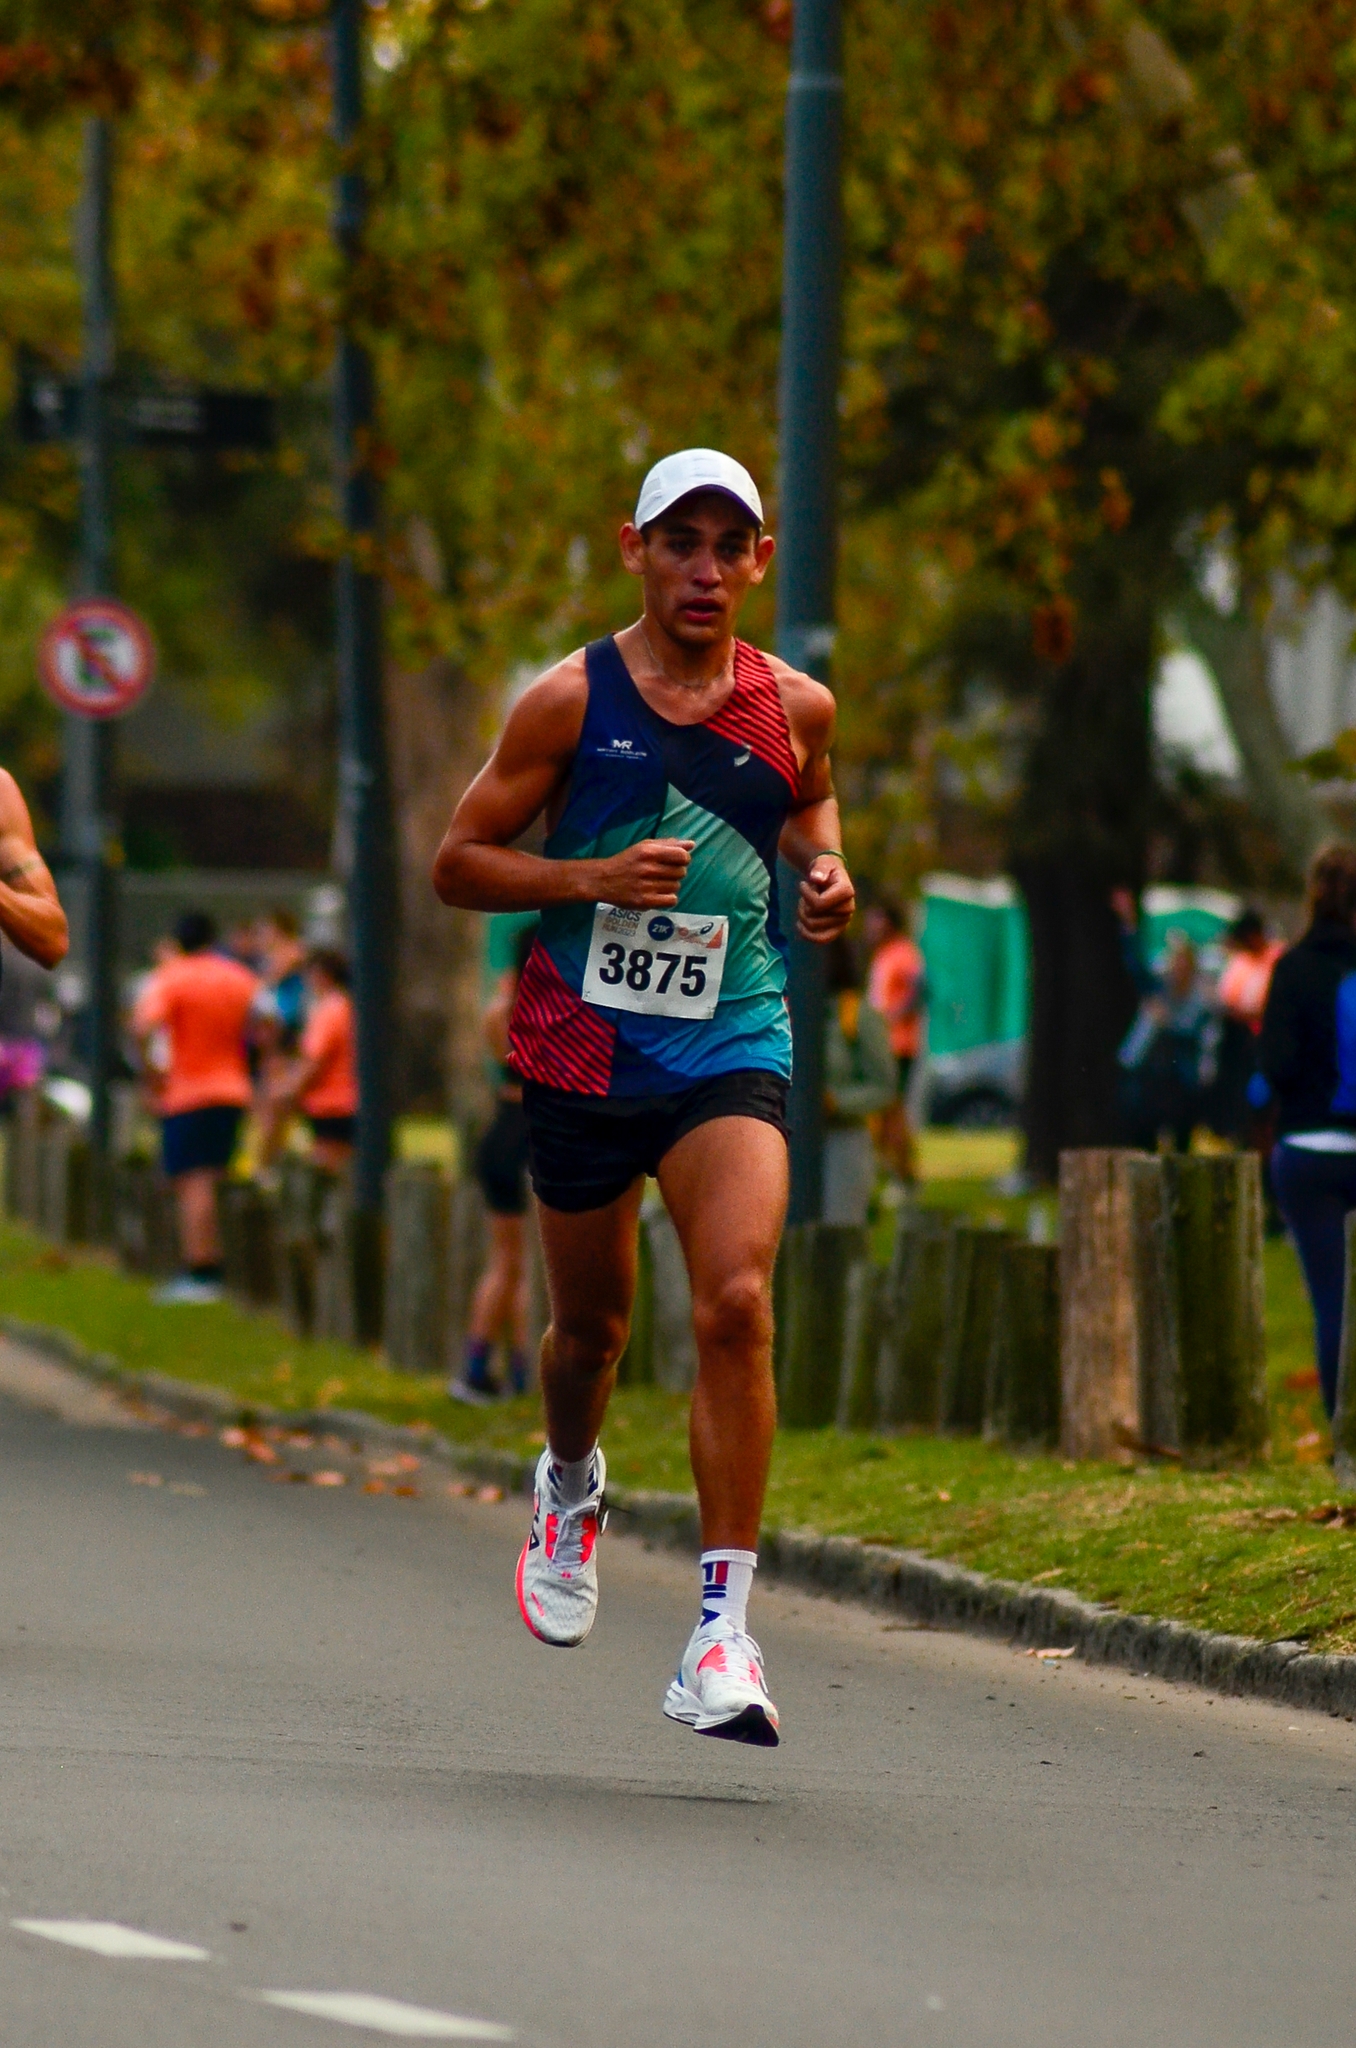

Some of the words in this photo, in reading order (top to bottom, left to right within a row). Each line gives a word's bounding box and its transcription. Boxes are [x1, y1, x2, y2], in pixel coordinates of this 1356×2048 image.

[608, 907, 642, 922] ASICS
[604, 916, 639, 930] GOLDEN
[651, 923, 671, 934] 21K
[599, 942, 708, 998] 3875
